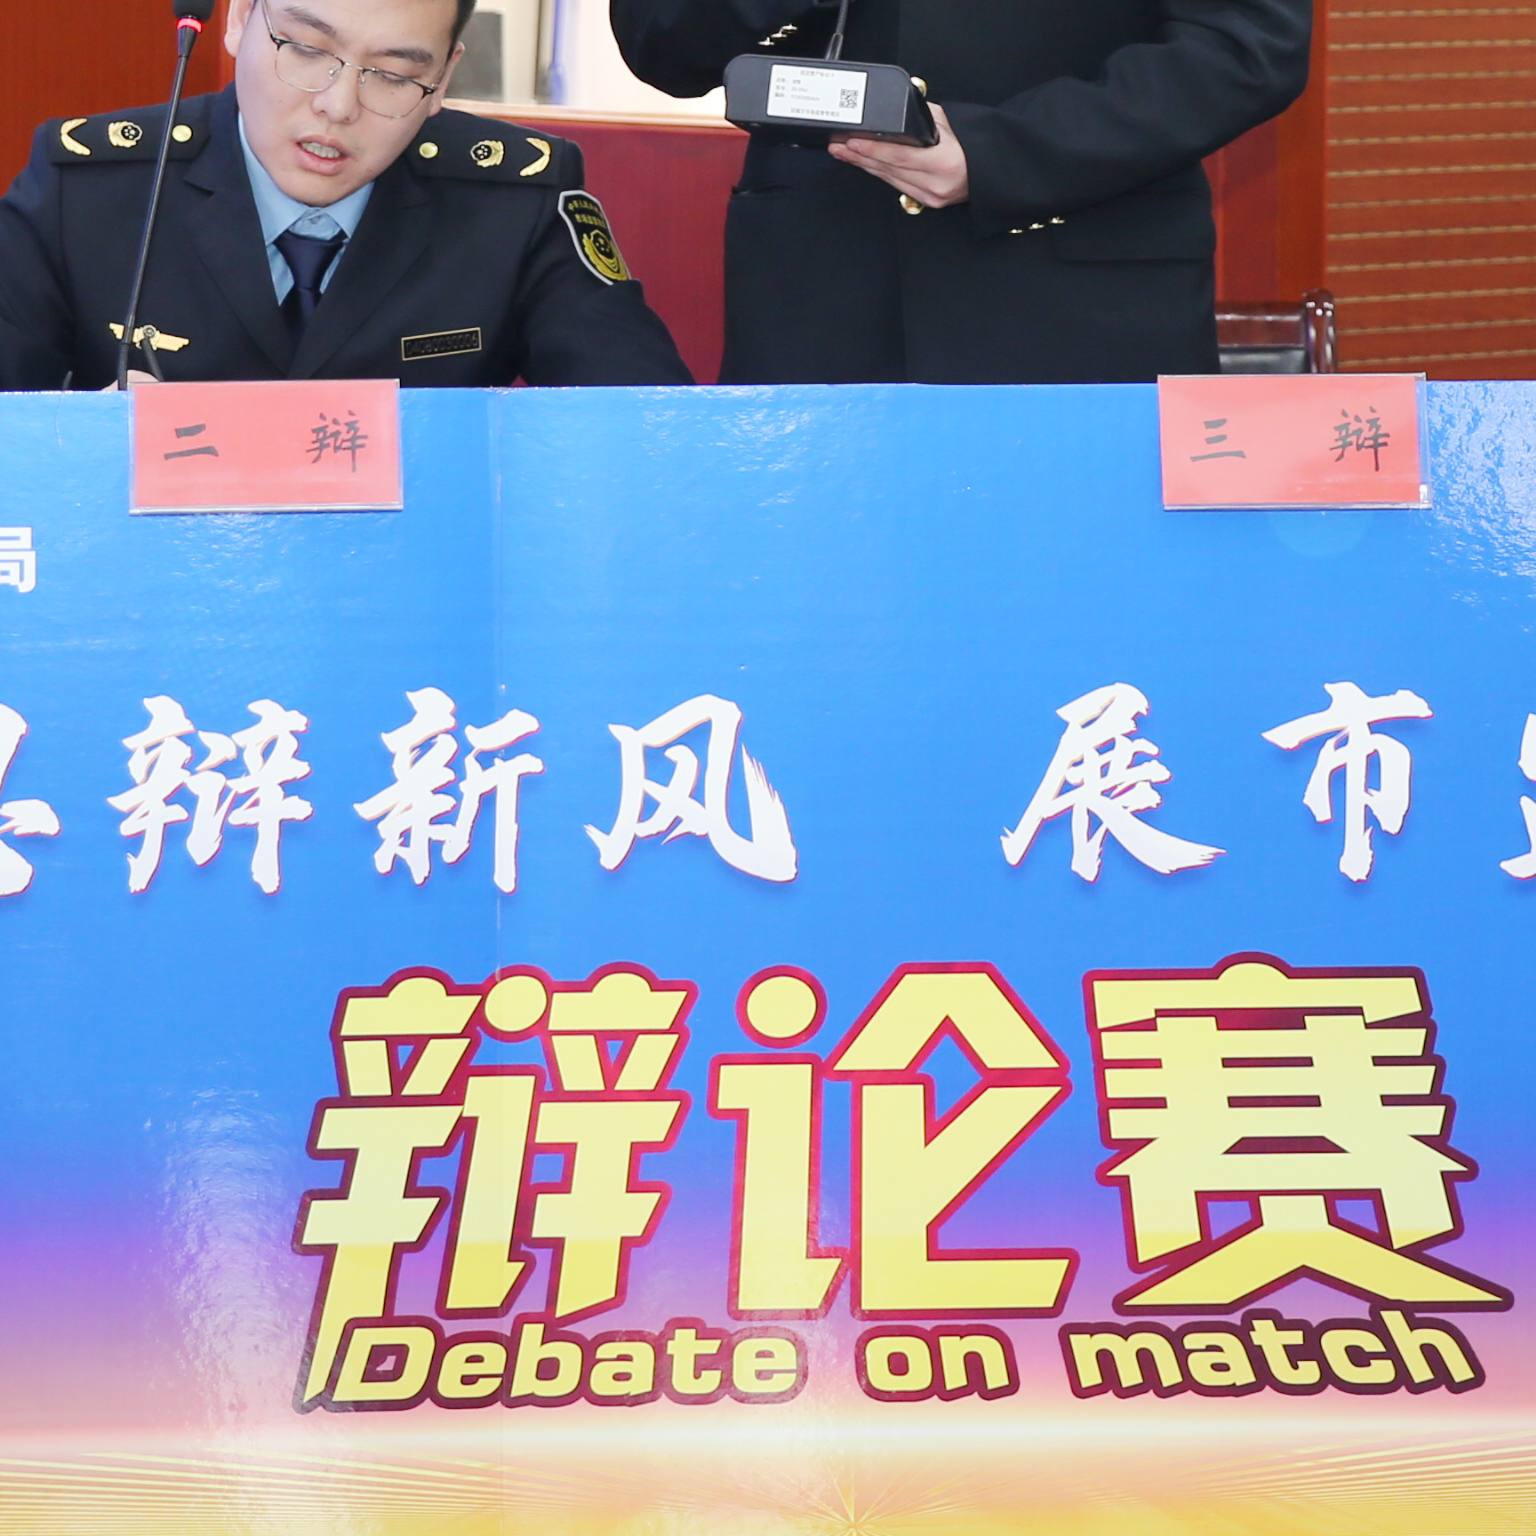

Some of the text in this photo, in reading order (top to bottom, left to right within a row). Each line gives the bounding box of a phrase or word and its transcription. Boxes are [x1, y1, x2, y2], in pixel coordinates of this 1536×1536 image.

[304, 961, 1506, 1404] 辩论赛
[330, 1309, 1477, 1404] Debate on match
